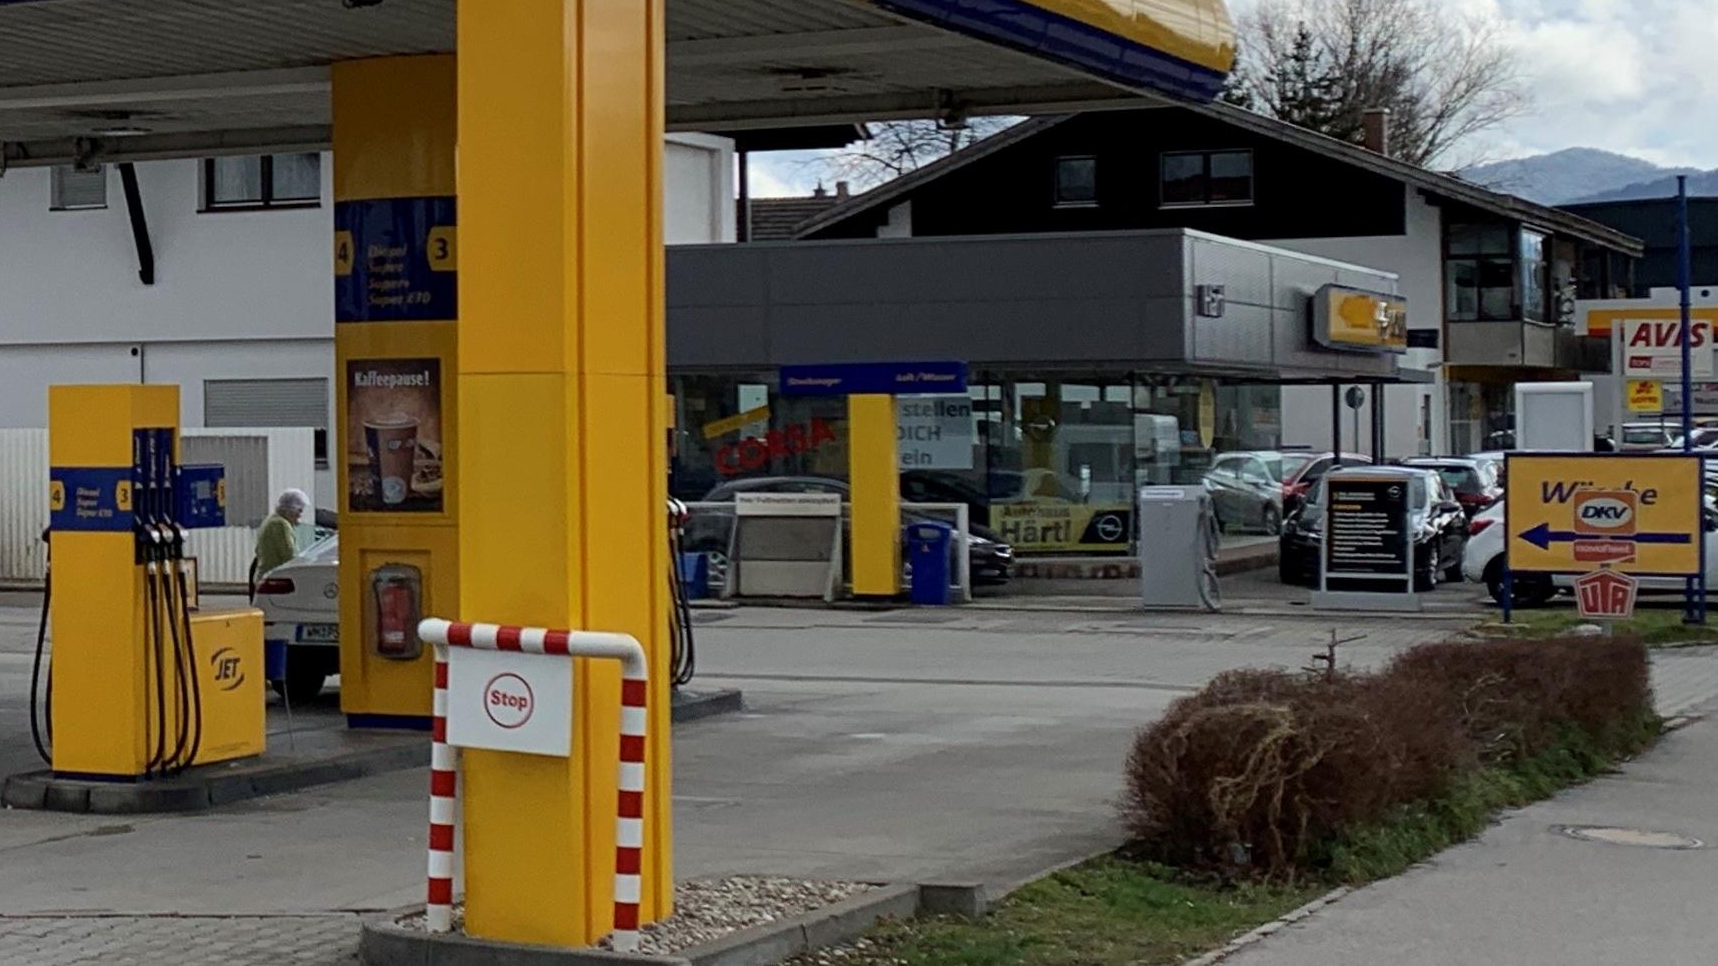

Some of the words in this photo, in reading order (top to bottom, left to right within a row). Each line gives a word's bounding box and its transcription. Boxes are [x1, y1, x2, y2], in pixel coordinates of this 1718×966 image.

[337, 240, 349, 263] 4
[433, 237, 449, 260] 3
[353, 369, 431, 390] Kaffeepause!
[903, 400, 971, 418] stellen
[902, 449, 933, 466] ein
[51, 490, 62, 504] 4
[119, 488, 130, 503] 3
[1581, 505, 1628, 520] DKV
[1000, 519, 1072, 545] Härtl
[1579, 574, 1632, 615] UTA
[214, 656, 241, 681] JET
[490, 689, 529, 712] Stop
